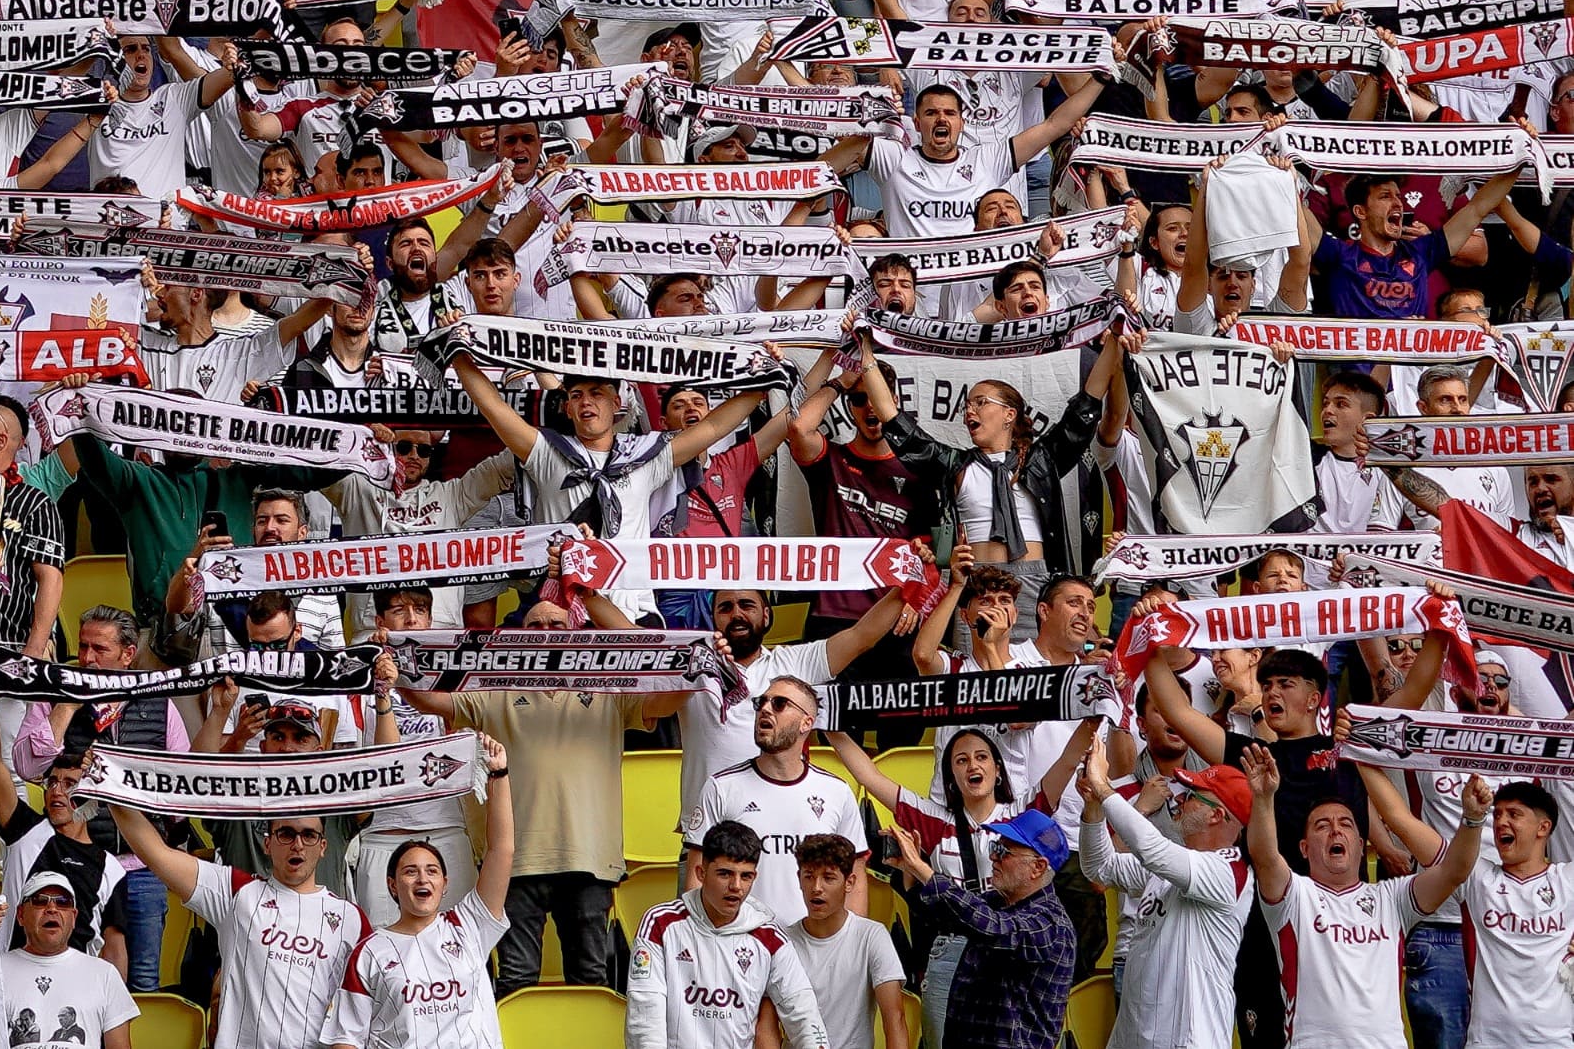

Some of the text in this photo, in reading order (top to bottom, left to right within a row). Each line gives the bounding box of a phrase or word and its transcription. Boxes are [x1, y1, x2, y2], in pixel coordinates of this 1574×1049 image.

[1286, 132, 1397, 157] ALBACETE
[601, 170, 711, 191] ALBACETE
[591, 234, 845, 259] albacete balompi
[489, 327, 607, 367] ALBACETE
[1238, 324, 1363, 349] ALBACETE
[112, 400, 222, 437] ALBACETE
[836, 484, 908, 524] SOLISS
[265, 542, 391, 582] ALBACETE
[649, 543, 839, 581] AUPA ALBA
[1206, 594, 1405, 642] AUPA ALBA
[432, 651, 549, 671] ALBACETE
[847, 682, 947, 710] ALBACETE
[122, 770, 259, 797] ALBACETE
[262, 923, 329, 959] iner
[1314, 914, 1389, 943] ETRUAL
[267, 950, 316, 969] ENERGÍA
[403, 979, 466, 1006] iner
[684, 980, 744, 1008] iner
[414, 1002, 460, 1016] ENERGÍA
